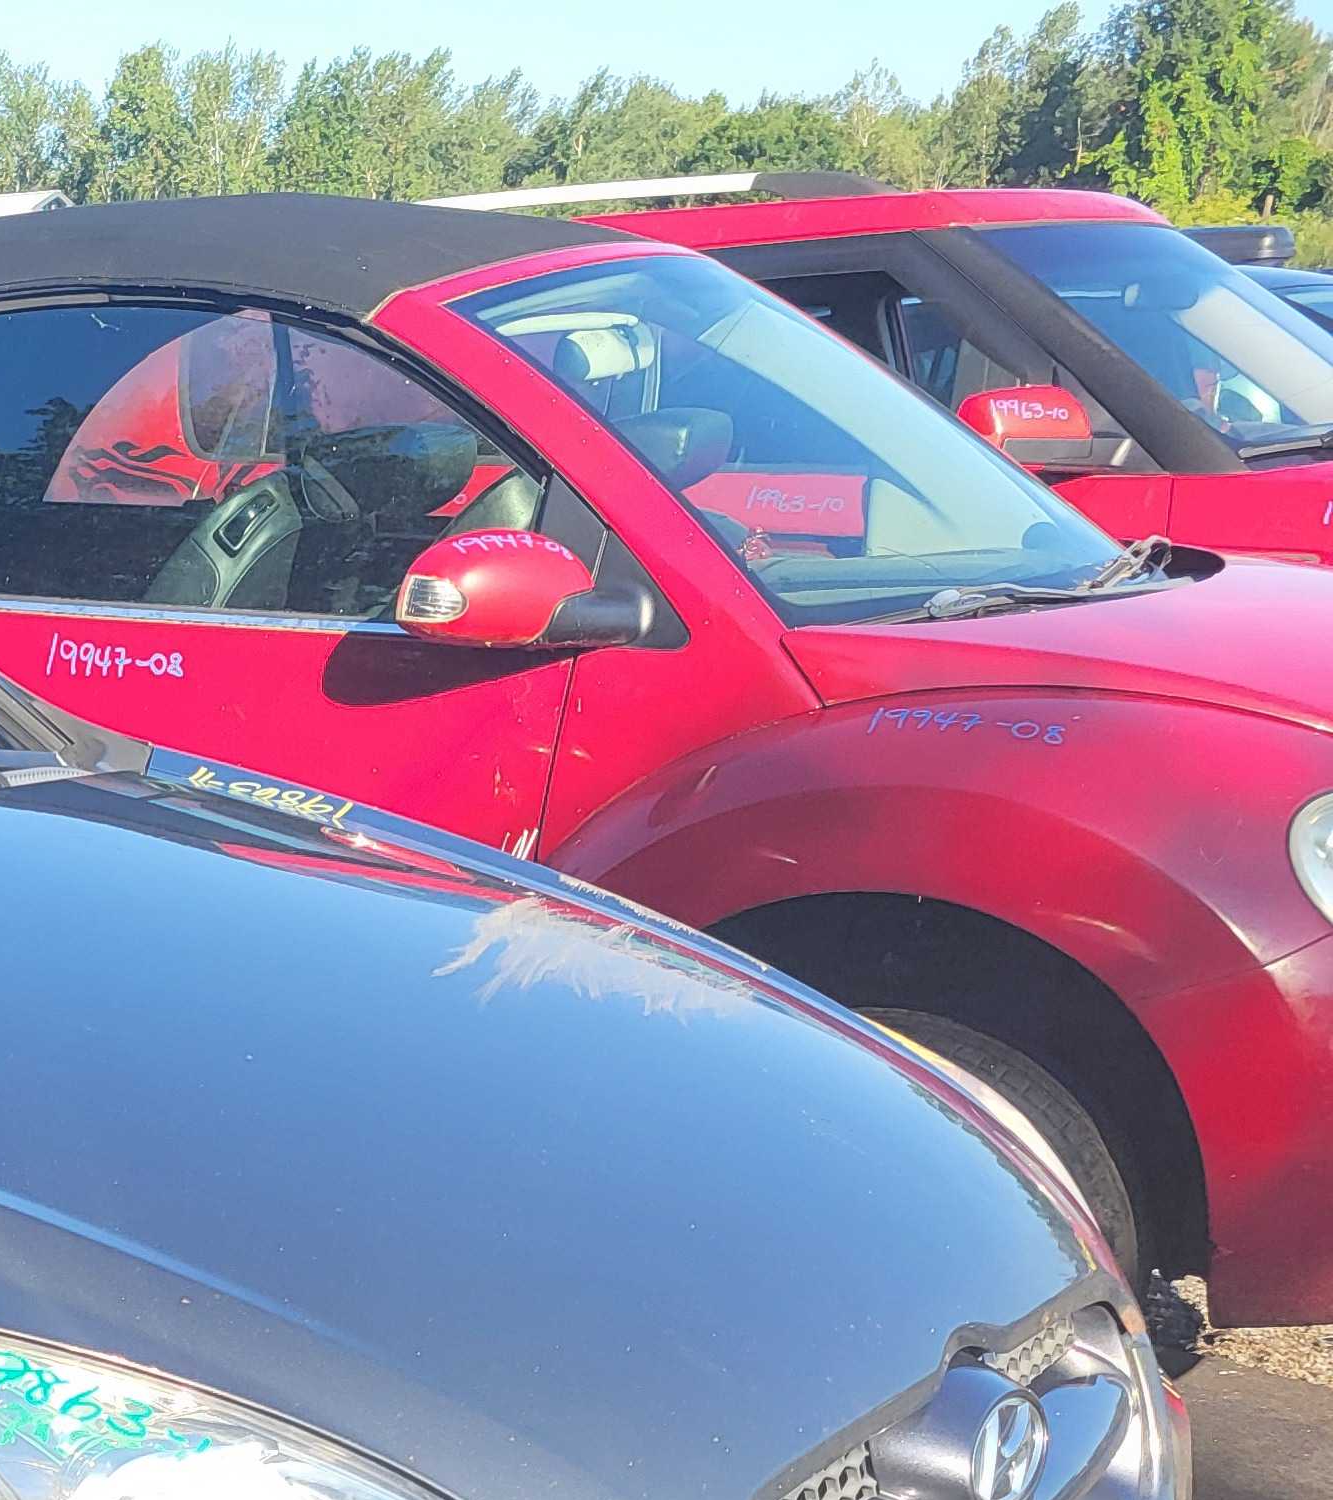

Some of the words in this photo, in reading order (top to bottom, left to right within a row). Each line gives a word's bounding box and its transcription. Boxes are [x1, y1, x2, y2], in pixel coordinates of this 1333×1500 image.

[990, 399, 1069, 420] 19963-10
[45, 632, 184, 678] 19947-08
[867, 708, 1066, 744] 19947-08
